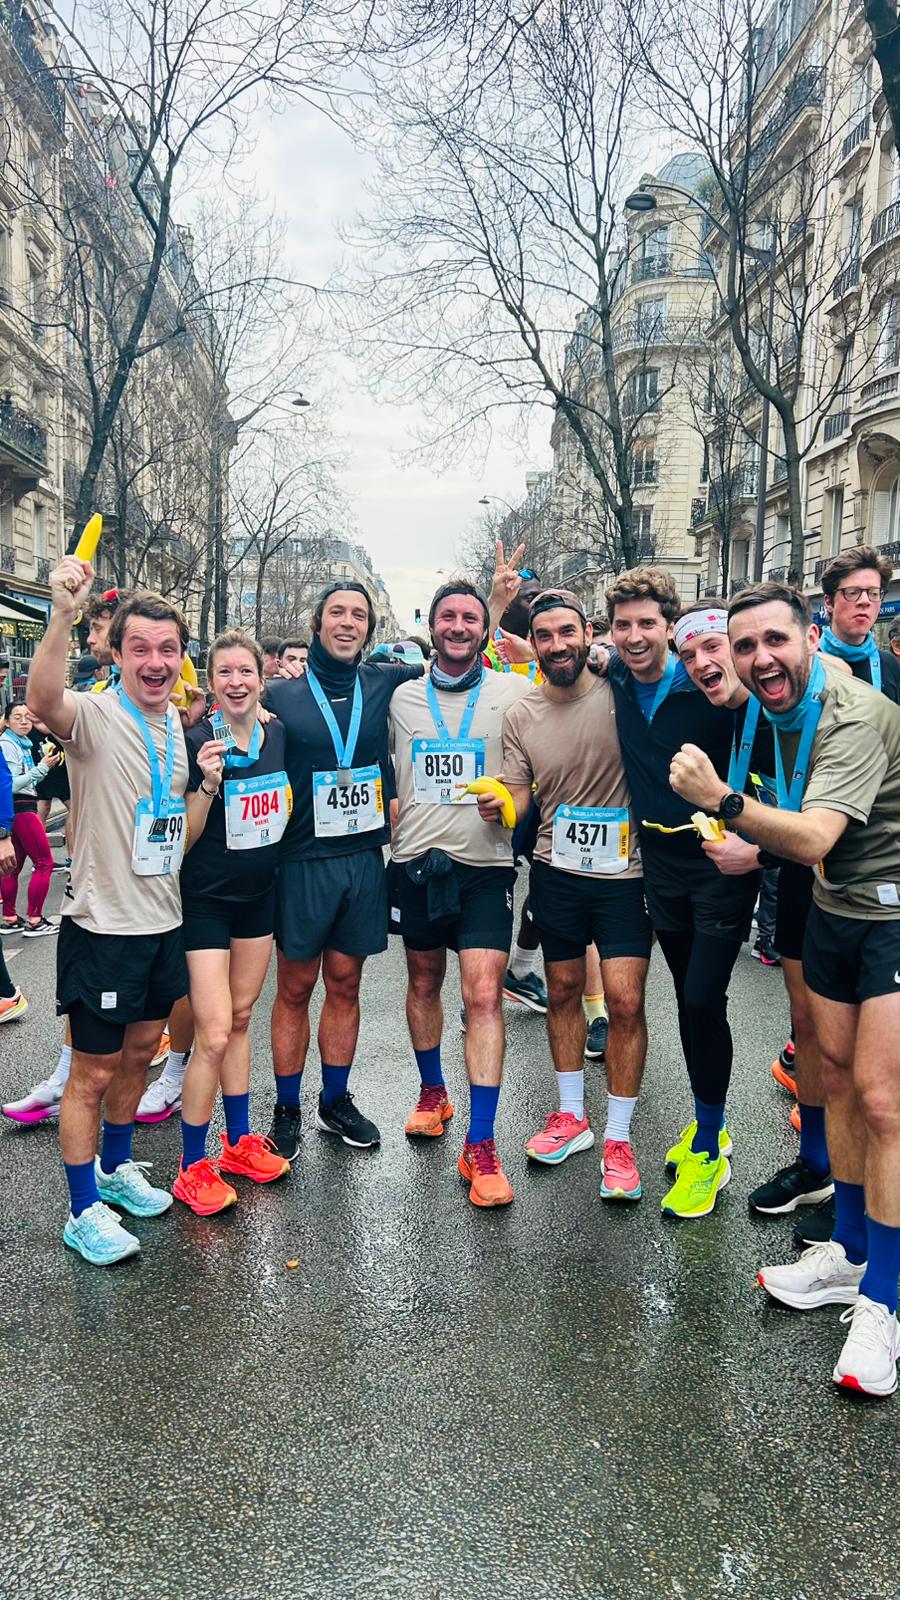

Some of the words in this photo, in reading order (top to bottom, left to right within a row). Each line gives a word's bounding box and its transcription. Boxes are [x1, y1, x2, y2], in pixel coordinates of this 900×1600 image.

[425, 754, 463, 777] 8130
[240, 790, 279, 821] 7084
[327, 783, 370, 810] 4365
[566, 822, 608, 846] 4371
